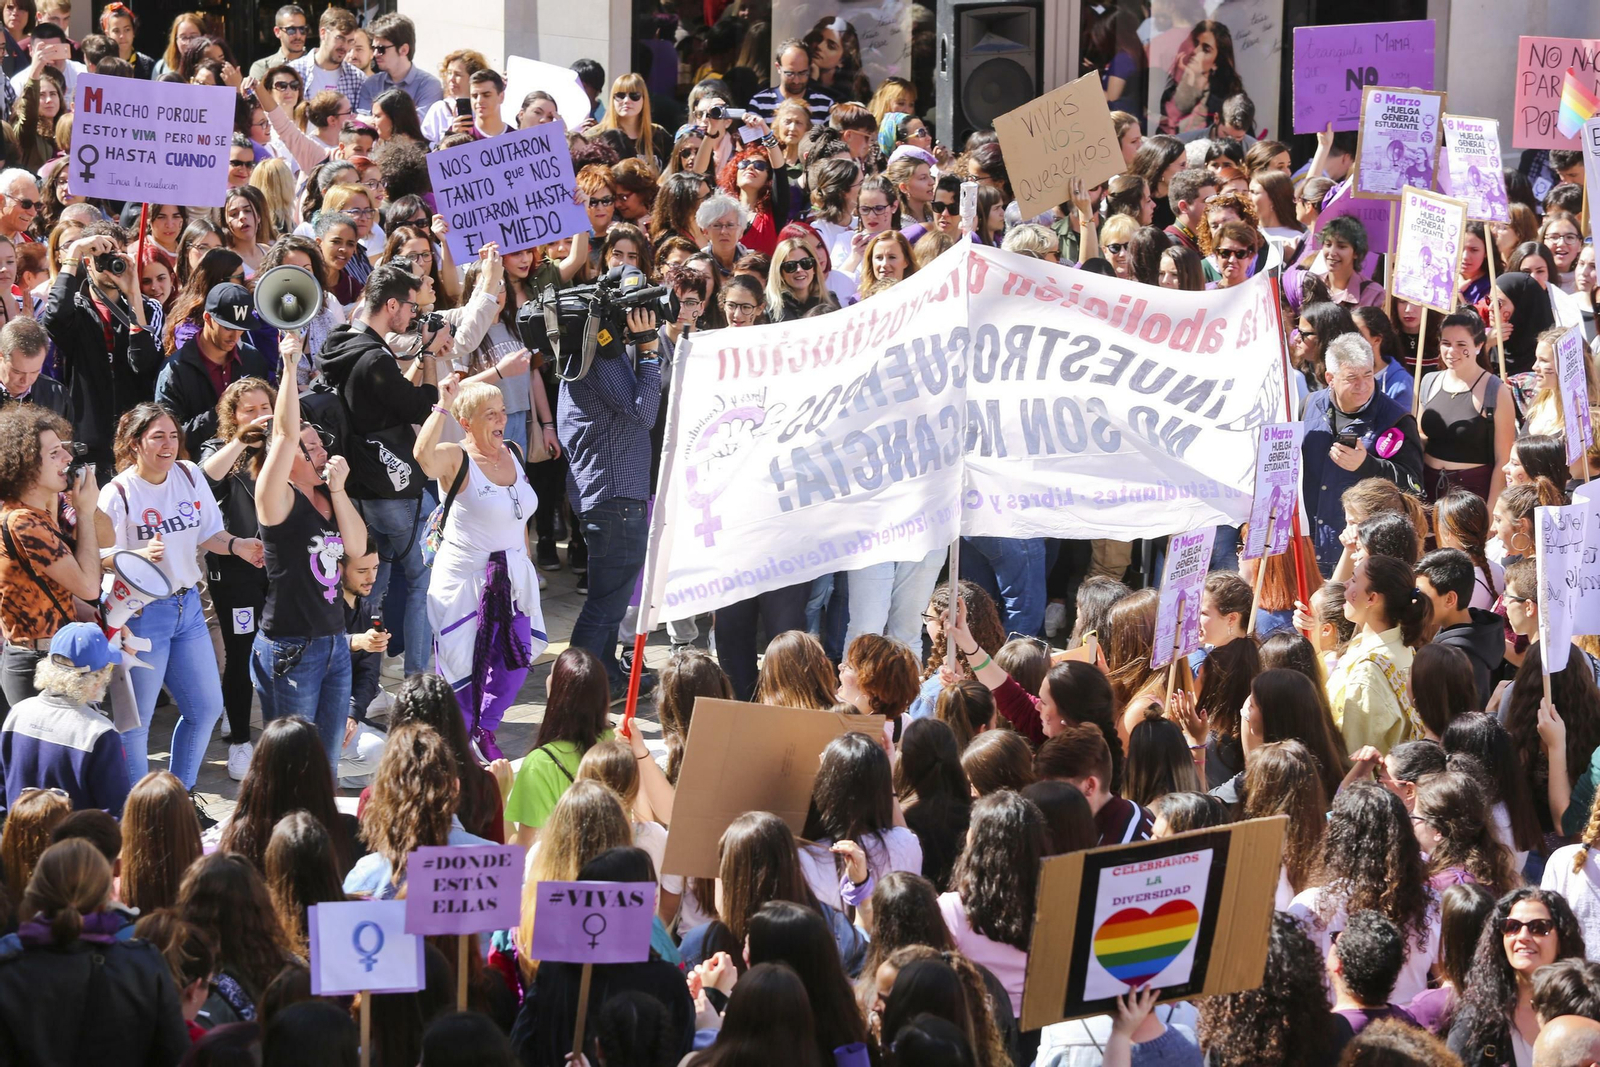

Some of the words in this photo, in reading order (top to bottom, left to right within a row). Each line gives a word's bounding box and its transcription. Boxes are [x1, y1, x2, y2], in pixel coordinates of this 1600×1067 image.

[1529, 43, 1562, 68] NO
[1345, 66, 1379, 91] NO
[1522, 71, 1561, 98] PAR
[83, 86, 149, 119] MARCHO
[157, 106, 208, 124] PORQUE
[1373, 93, 1382, 103] 8
[1385, 94, 1421, 107] Marzo
[1021, 94, 1079, 137] VIVAS
[1381, 114, 1420, 123] GENERAL
[1386, 106, 1420, 116] HUELGA
[1374, 120, 1419, 131] ESTUDIANTIL
[1448, 120, 1454, 130] 8
[1457, 120, 1483, 132] Marzo
[83, 124, 127, 138] ESTOY
[132, 129, 156, 141] VIVA
[165, 132, 193, 144] PERO
[197, 134, 211, 145] NO
[214, 136, 227, 146] SE
[1043, 122, 1085, 154] NOS
[1459, 132, 1484, 141] HUELGA
[1455, 146, 1487, 155] ESTUDIANTIL
[1458, 140, 1486, 148] GENERAL
[106, 146, 156, 164] HASTA
[165, 152, 216, 168] CUANDO
[439, 154, 472, 180] NOS
[480, 134, 551, 167] QUITARON
[440, 177, 495, 208] TANTO
[530, 156, 561, 181] NOS
[452, 197, 519, 230] QUITARON
[525, 183, 574, 212] HASTA
[1411, 196, 1417, 206] 8
[1420, 198, 1446, 215] Marzo
[1416, 218, 1444, 232] GENERAL
[1420, 210, 1445, 224] HUELGA
[498, 211, 561, 248] MIEDO
[1411, 224, 1444, 239] ESTUDIANTIL
[233, 305, 248, 321] W
[1264, 428, 1269, 441] 8
[1271, 427, 1293, 440] Marzo
[1272, 441, 1292, 451] HUELGA
[1268, 450, 1290, 462] GENERAL
[1264, 461, 1290, 472] ESTUDIANTIL
[1173, 538, 1179, 552] 8
[1180, 534, 1204, 549] Marzo
[1180, 544, 1202, 559] HUELGA
[1175, 554, 1200, 570] GENERAL
[1170, 564, 1199, 581] ESTUDIANTIL
[422, 854, 512, 870] #DONDE
[1112, 854, 1200, 876] CELEBRAMOS
[433, 873, 499, 892] ESTÁN
[1146, 876, 1162, 886] LA
[549, 890, 644, 908] #VIVAS
[1112, 884, 1191, 906] DIVERSIDAD
[432, 898, 498, 914] ELLAS
